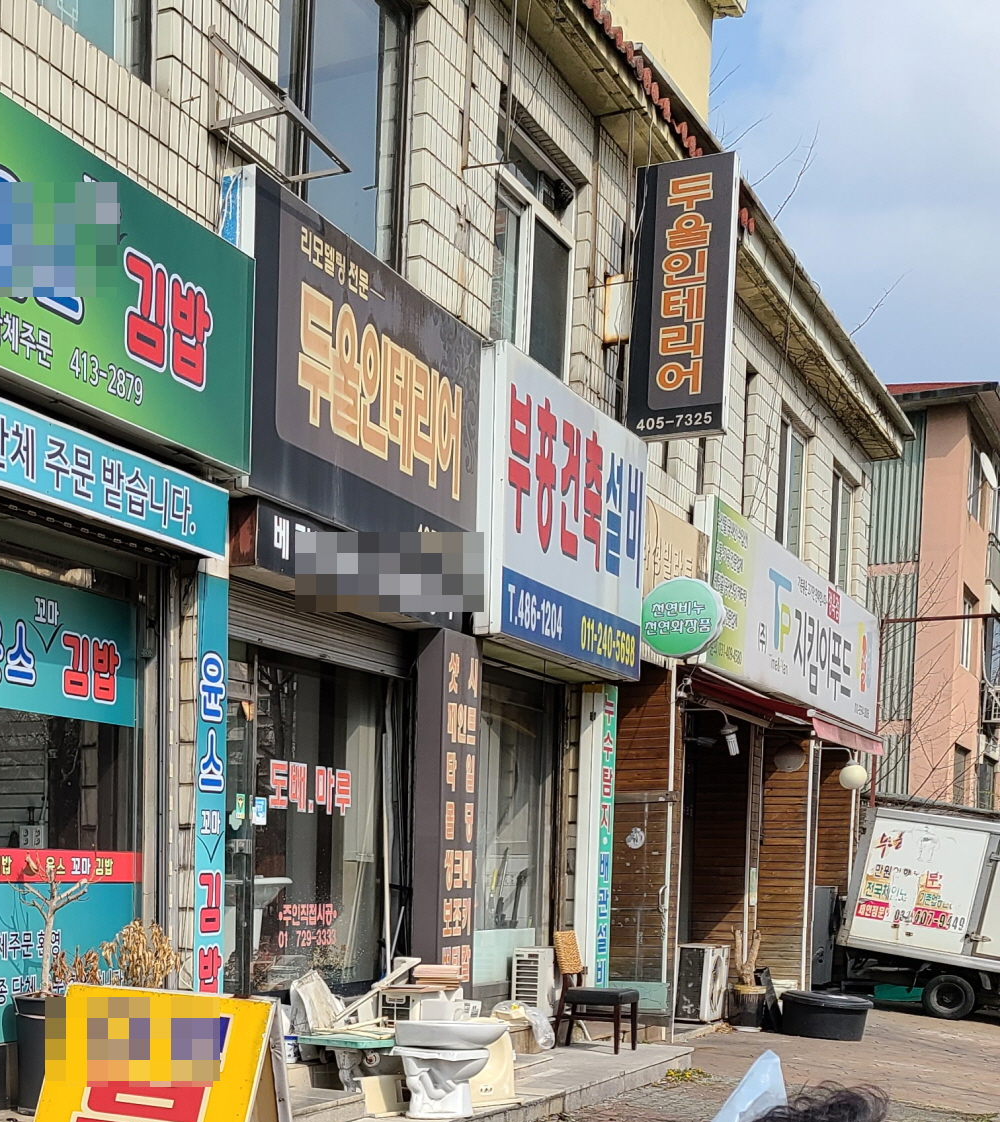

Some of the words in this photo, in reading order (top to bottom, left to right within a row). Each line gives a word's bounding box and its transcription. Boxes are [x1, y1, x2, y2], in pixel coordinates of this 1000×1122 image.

[301, 226, 346, 285] 리모델링
[348, 262, 369, 301] 전문
[656, 172, 713, 395] 두울인테리어
[123, 246, 214, 392] 김밥
[69, 347, 144, 406] 413-2879
[298, 281, 462, 501] 두울인테리어
[636, 411, 713, 431] 405-7325
[44, 435, 95, 501] 주문
[101, 456, 196, 536] 받습니다.
[508, 583, 563, 641] T.486-1204
[644, 619, 712, 636] 천연화장품
[652, 601, 705, 617] 천연비누
[34, 596, 60, 627] 꼬마
[61, 630, 121, 704] 김밥
[581, 615, 636, 668] 011-240-5698
[793, 608, 852, 701] 지킴이푸드
[447, 702, 477, 745] 페인트
[201, 809, 221, 836] 꼬마
[71, 857, 91, 875] 꼬마
[96, 857, 113, 876] 김밥
[443, 897, 471, 937] 보조키
